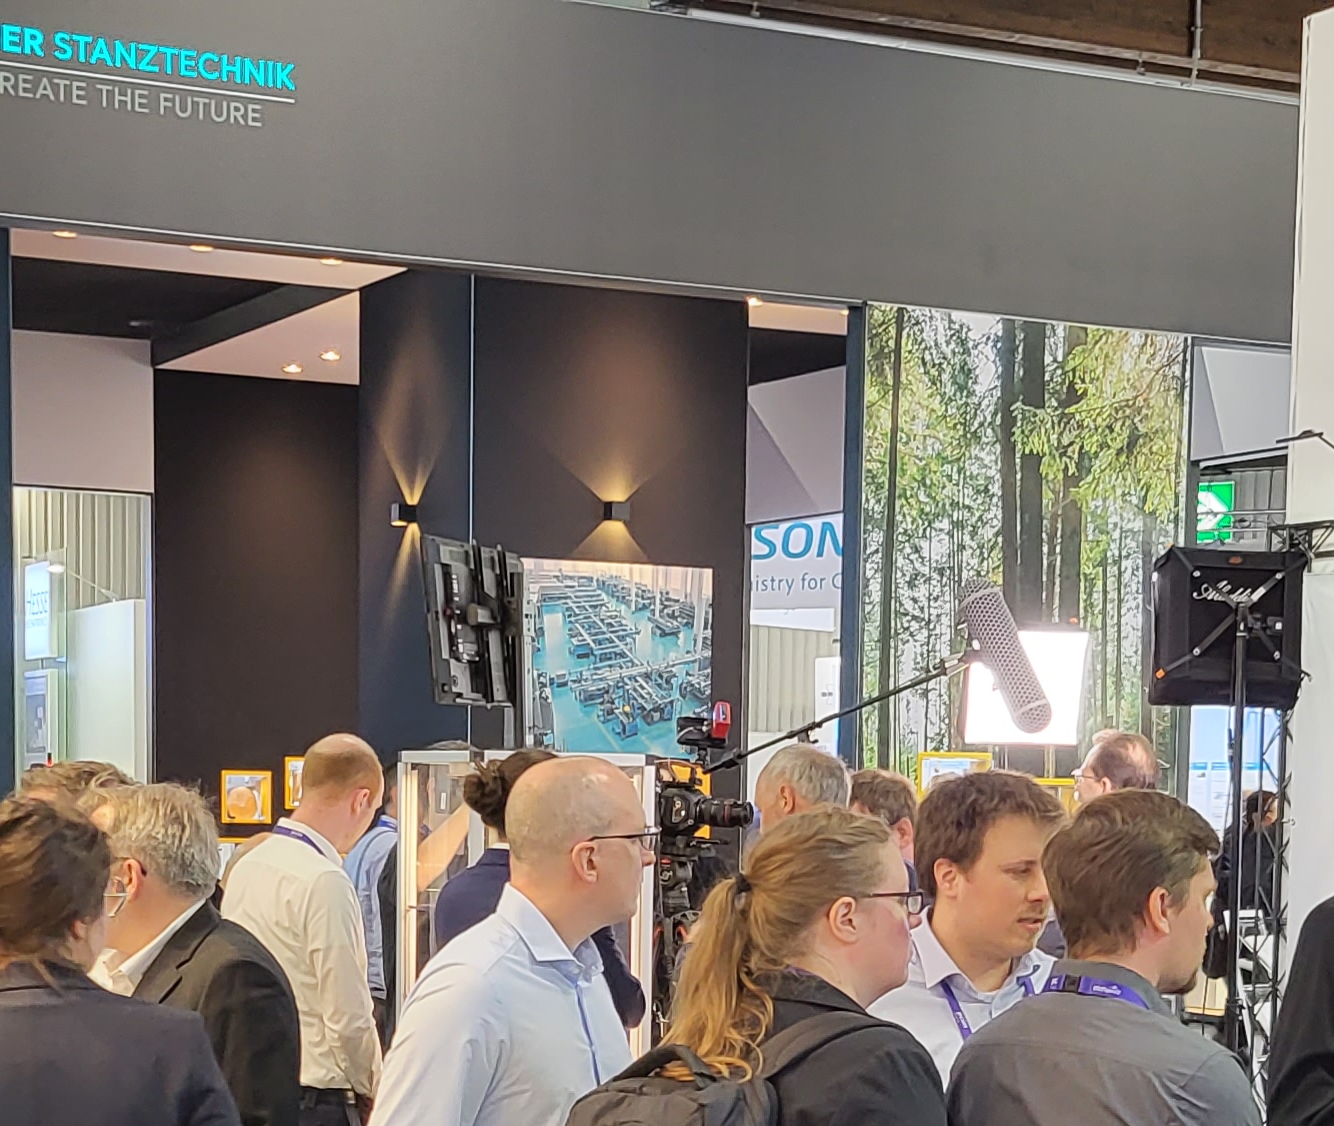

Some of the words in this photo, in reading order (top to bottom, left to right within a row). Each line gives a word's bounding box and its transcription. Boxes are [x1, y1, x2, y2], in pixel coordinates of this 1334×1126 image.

[53, 31, 296, 91] STANZTECHNIK
[95, 84, 149, 113] THE
[159, 92, 263, 127] FUTURE
[801, 571, 826, 590] for
